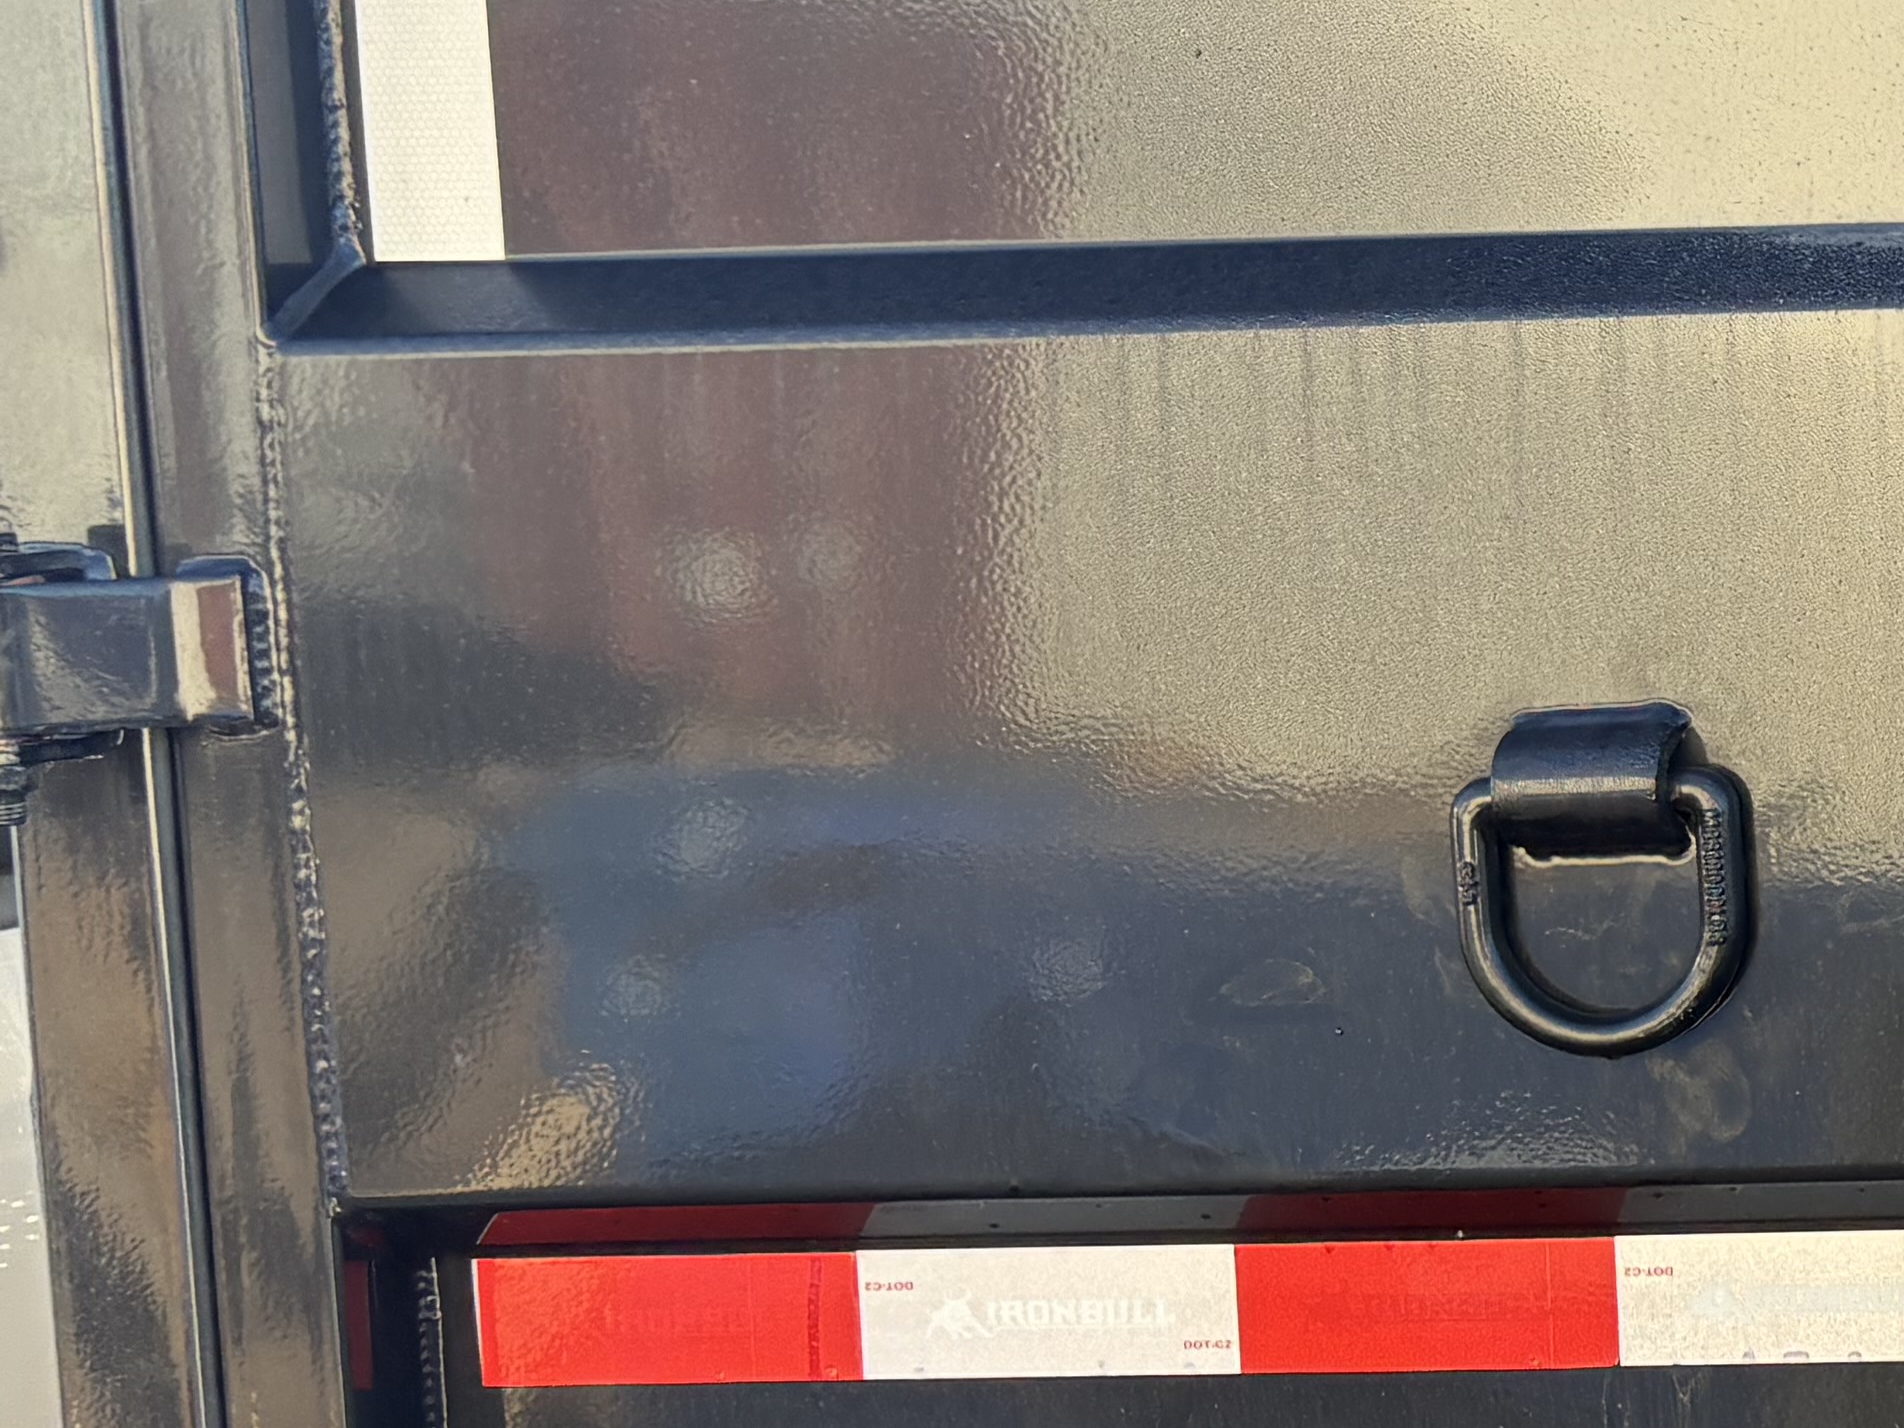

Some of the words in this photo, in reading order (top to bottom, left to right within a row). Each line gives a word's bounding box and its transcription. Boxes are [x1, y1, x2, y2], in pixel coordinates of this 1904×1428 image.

[1624, 1267, 1673, 1277] DOT-C2
[865, 1281, 914, 1292] DOT-C2
[986, 1298, 1176, 1328] IRONBULL
[1183, 1339, 1232, 1350] DOT-C2
